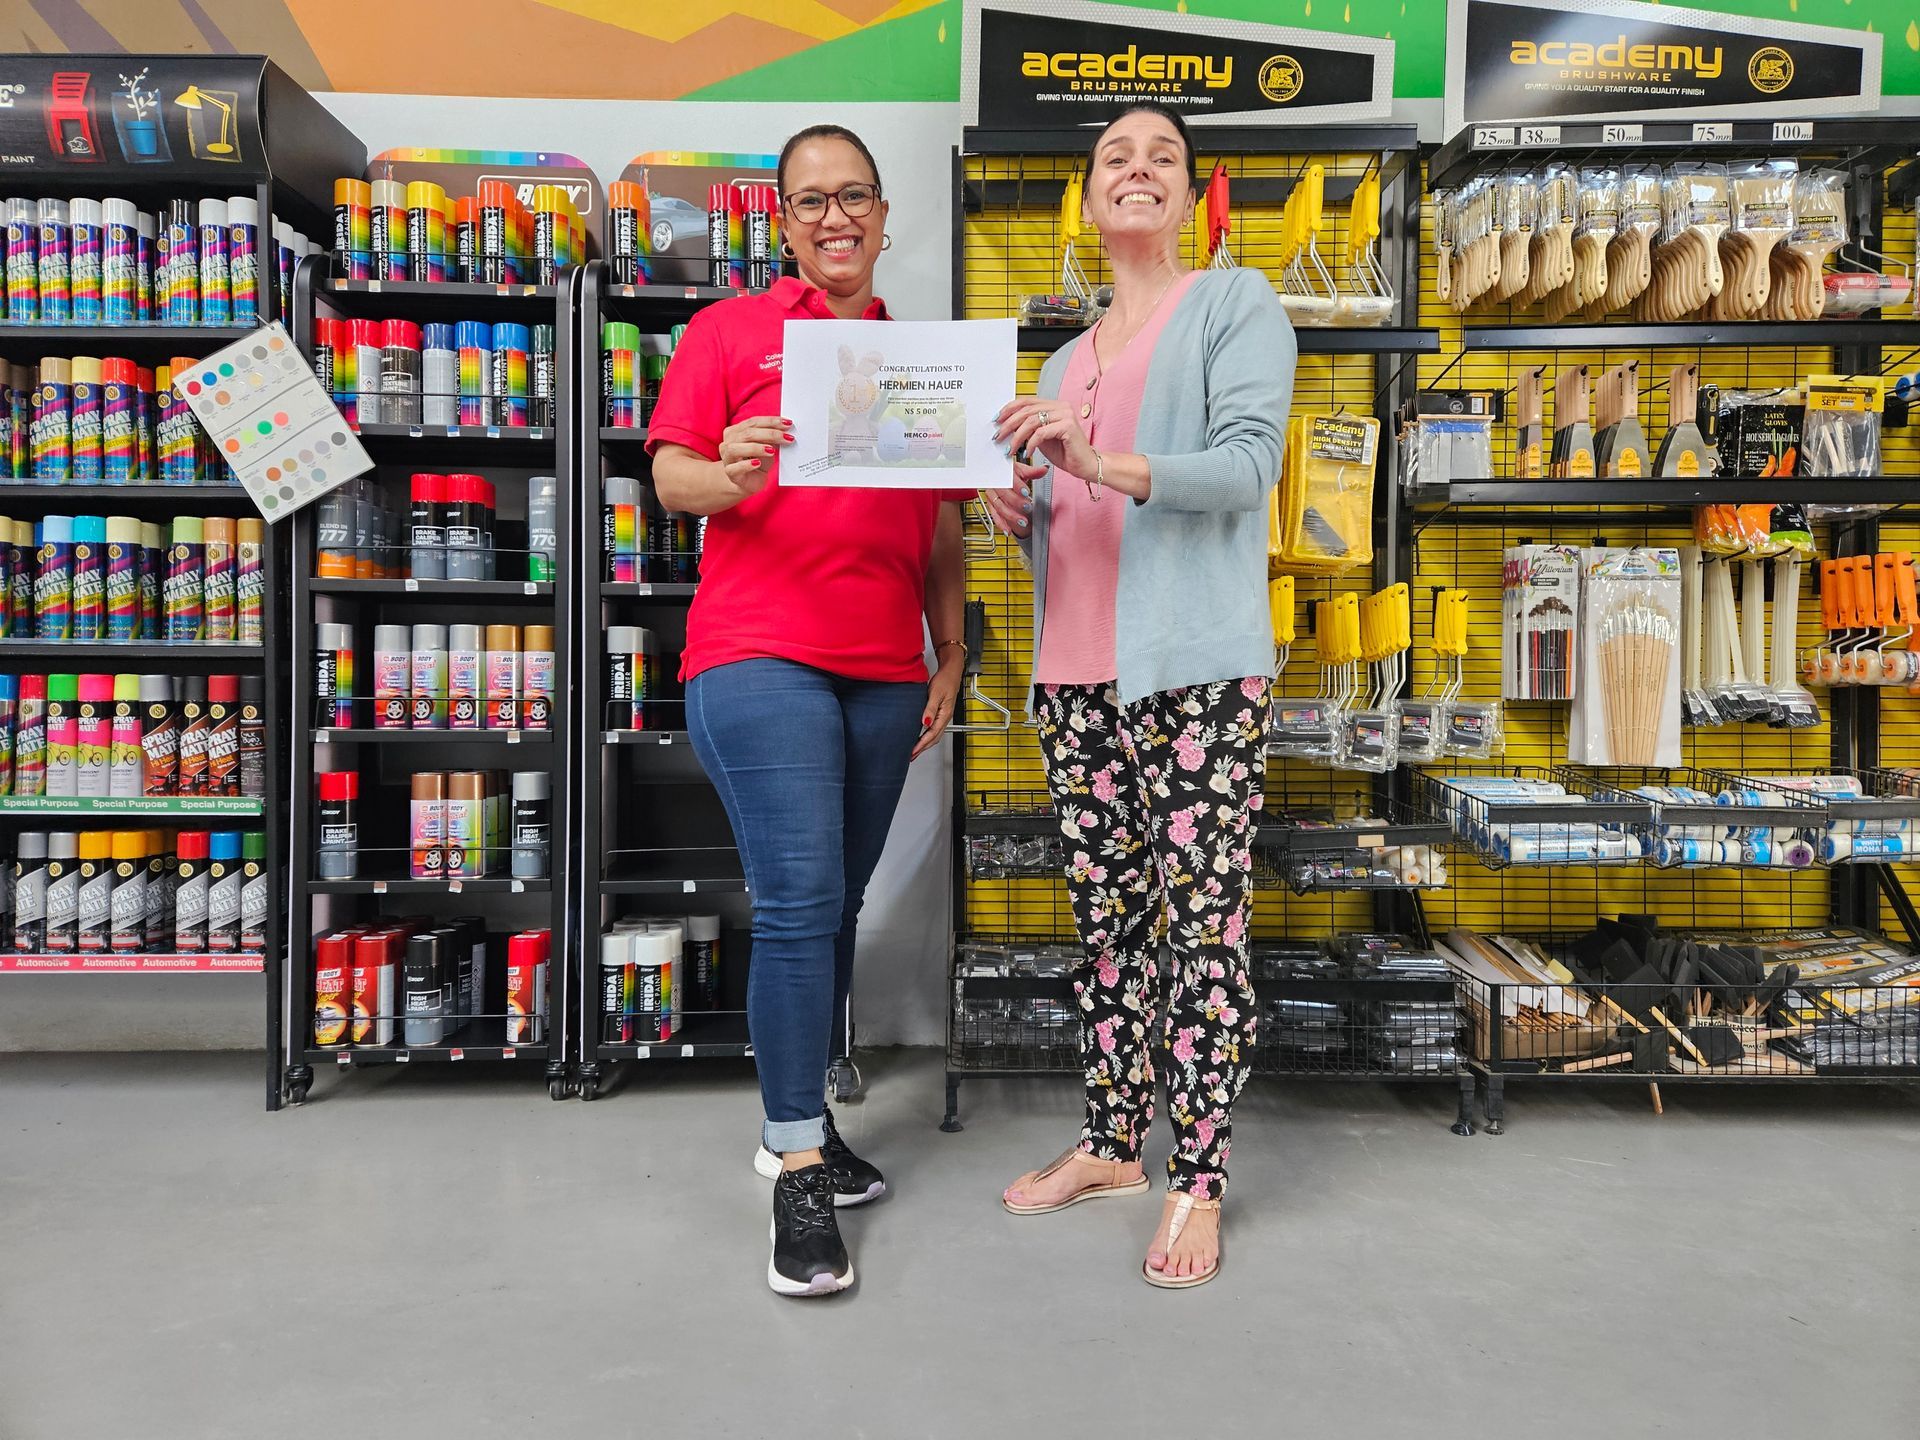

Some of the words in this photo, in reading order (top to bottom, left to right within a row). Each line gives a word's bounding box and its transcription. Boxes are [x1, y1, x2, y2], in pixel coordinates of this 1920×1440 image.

[1510, 35, 1723, 79] academy
[1022, 44, 1233, 88] academy
[1560, 70, 1672, 82] BRUSHWARE
[1070, 81, 1182, 92] BRUSHWARE
[1574, 84, 1603, 92] QUALITY
[1604, 85, 1627, 93] START
[1629, 86, 1643, 94] FOR
[1643, 86, 1649, 94] A
[1650, 87, 1680, 95] QUALITY
[1682, 88, 1705, 96] FINISH
[1036, 94, 1060, 102] GIVING
[1077, 94, 1083, 102] A
[1084, 94, 1114, 102] QUALITY
[1114, 95, 1138, 103] START
[1159, 96, 1189, 104] QUALITY
[1478, 131, 1514, 145] 25mm
[1524, 130, 1560, 144] 38mm
[1607, 128, 1642, 143] 50mm
[1698, 127, 1732, 142] 75mm
[2, 155, 35, 164] PAINT
[516, 184, 582, 206] BY
[879, 380, 925, 390] HERMIEN
[928, 380, 963, 390] HAUER
[1315, 422, 1365, 437] academy
[1333, 438, 1362, 447] DENSITY
[1746, 432, 1781, 442] HOUSEHOLD
[320, 530, 348, 541] 777
[532, 534, 556, 546] 770
[318, 660, 328, 696] IRIDA
[614, 662, 624, 698] IRIDA
[141, 727, 176, 750] SPRAY
[4, 799, 38, 808] Special
[40, 800, 79, 808] Purpose
[92, 800, 127, 808] Special
[129, 800, 168, 808] Purpose
[181, 800, 215, 809] Special
[218, 800, 257, 809] Purpose
[16, 959, 70, 967] Automotive
[83, 959, 136, 967] Automotive
[143, 959, 197, 967] Automotive
[1870, 966, 1905, 984] DROP
[606, 974, 617, 1011] IRIDA
[644, 975, 654, 1011] IRIDA
